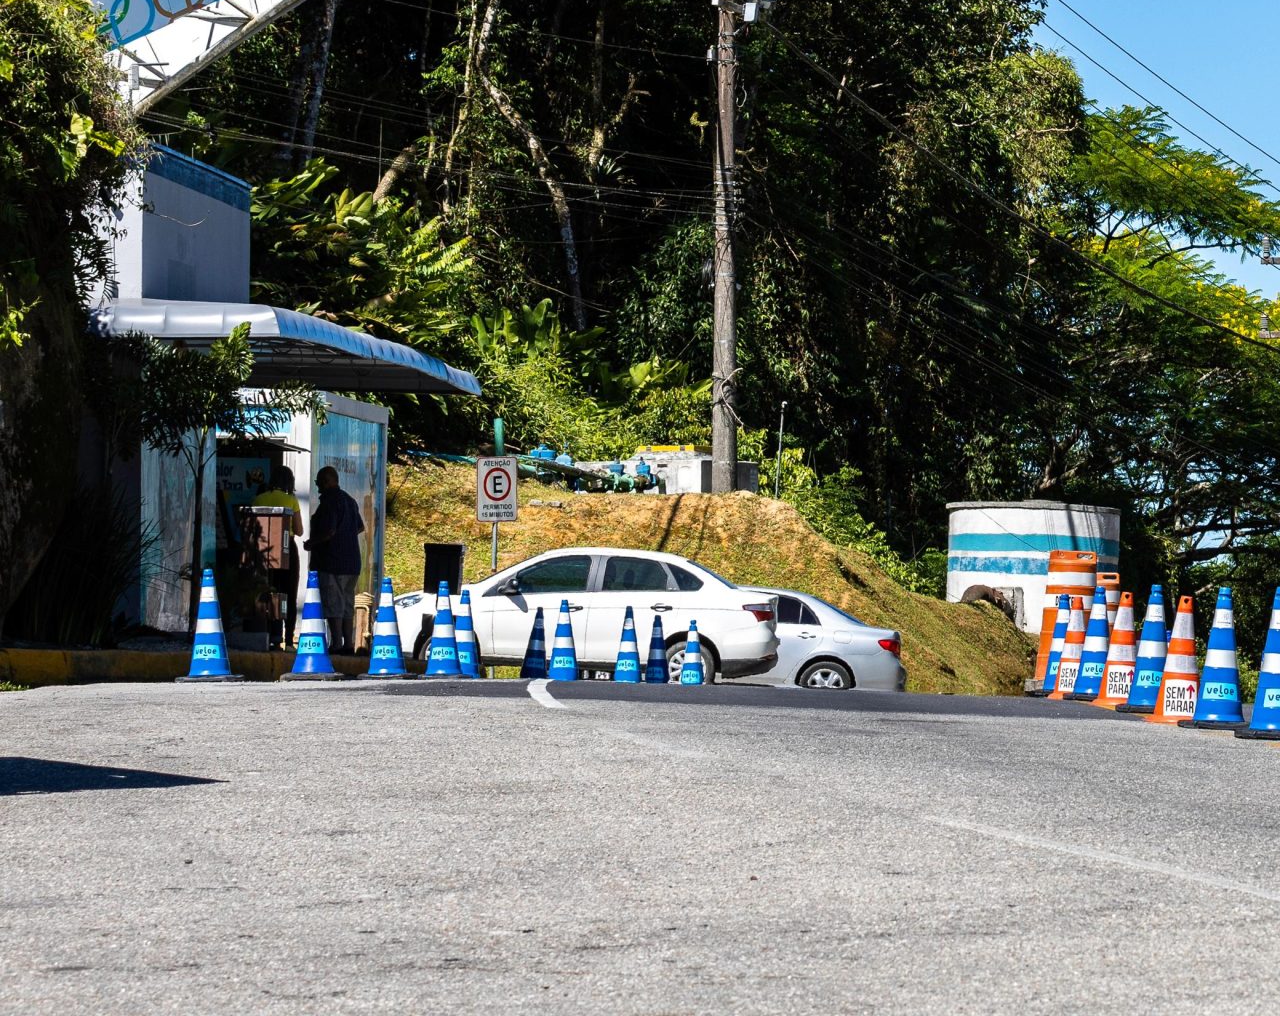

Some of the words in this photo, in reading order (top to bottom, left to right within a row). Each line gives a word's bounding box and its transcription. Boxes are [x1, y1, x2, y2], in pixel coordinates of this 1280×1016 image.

[483, 459, 511, 468] ATENÇÃO
[493, 475, 503, 494] E
[300, 639, 321, 650] veloe
[195, 647, 217, 657] veloe
[375, 646, 395, 657] veloe
[432, 647, 453, 658] veloe
[1061, 667, 1077, 679] SEM
[1085, 664, 1104, 675] velo
[1108, 671, 1127, 684] SEM
[1140, 672, 1161, 685] velo
[1060, 678, 1074, 689] PAR
[1108, 684, 1129, 695] PARA
[1166, 686, 1185, 700] SEM
[1206, 684, 1235, 698] veloe
[1165, 699, 1194, 714] PARAR
